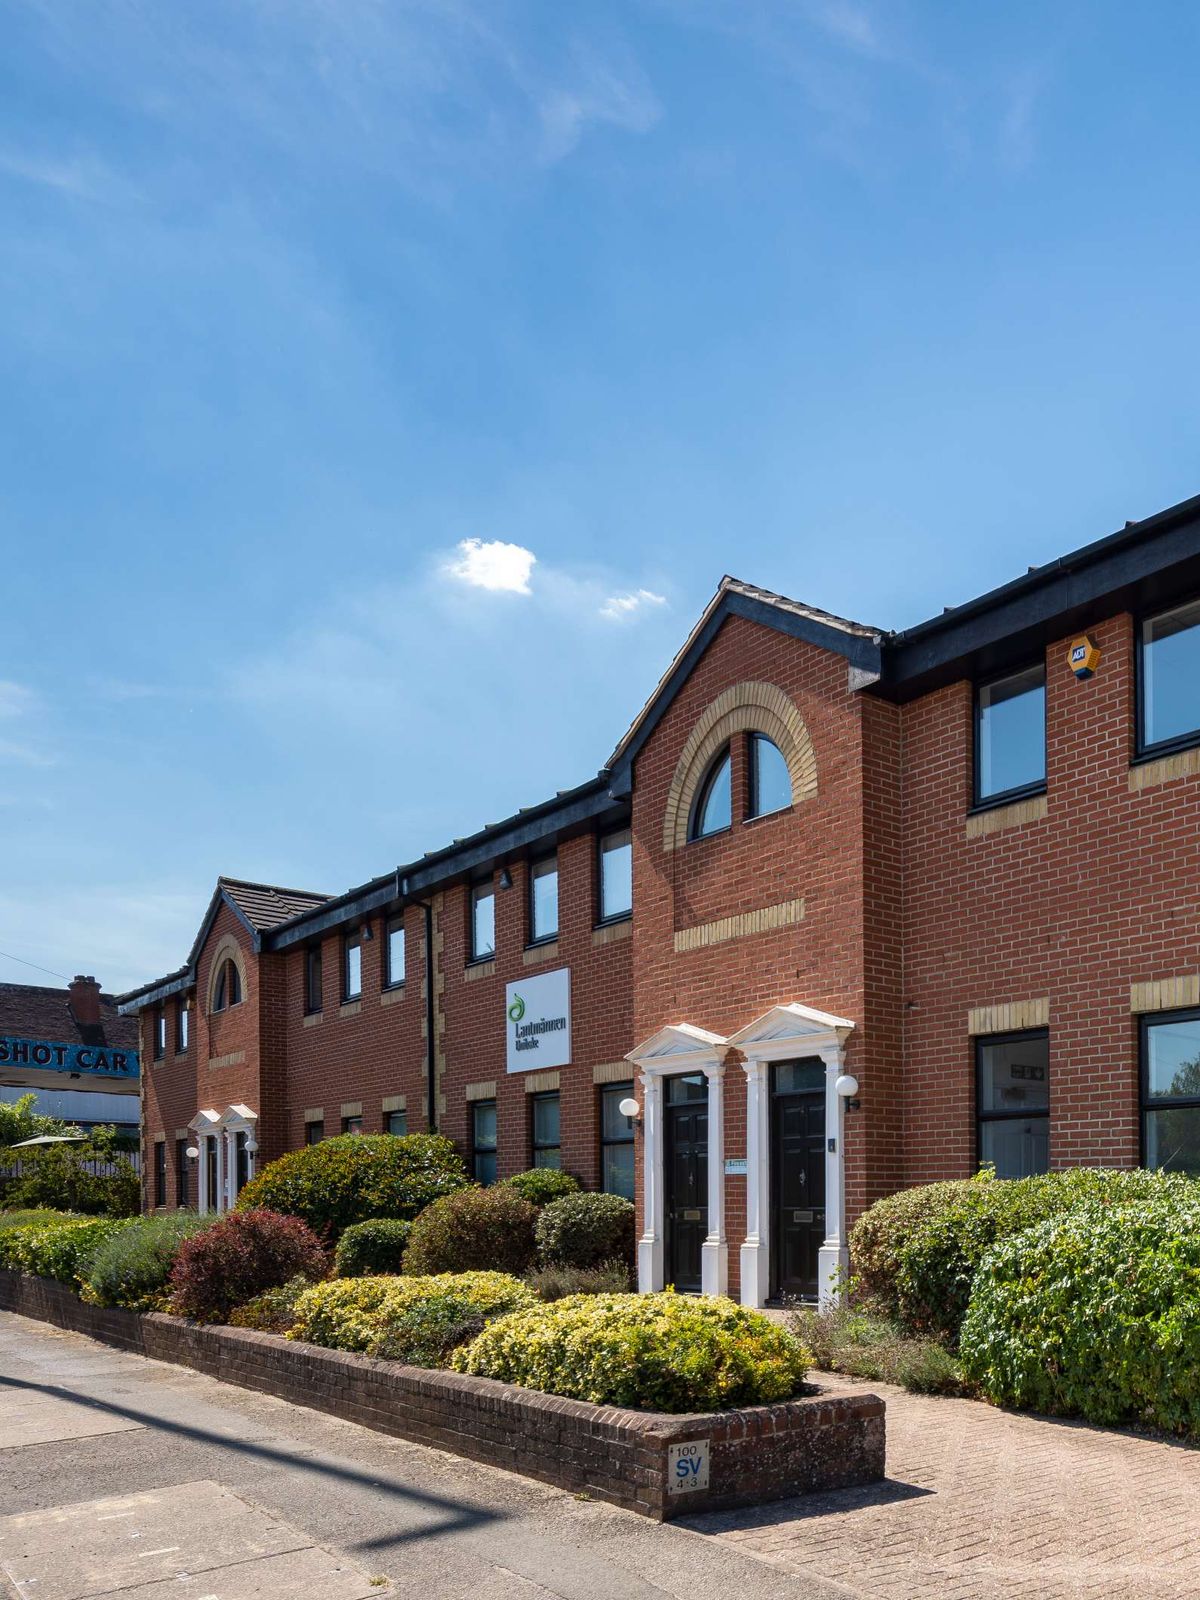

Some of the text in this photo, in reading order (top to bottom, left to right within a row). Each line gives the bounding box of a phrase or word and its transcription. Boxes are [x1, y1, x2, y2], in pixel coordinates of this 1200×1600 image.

[76, 1049, 129, 1072] CAR
[677, 1445, 697, 1457] 100
[676, 1457, 702, 1478] SV
